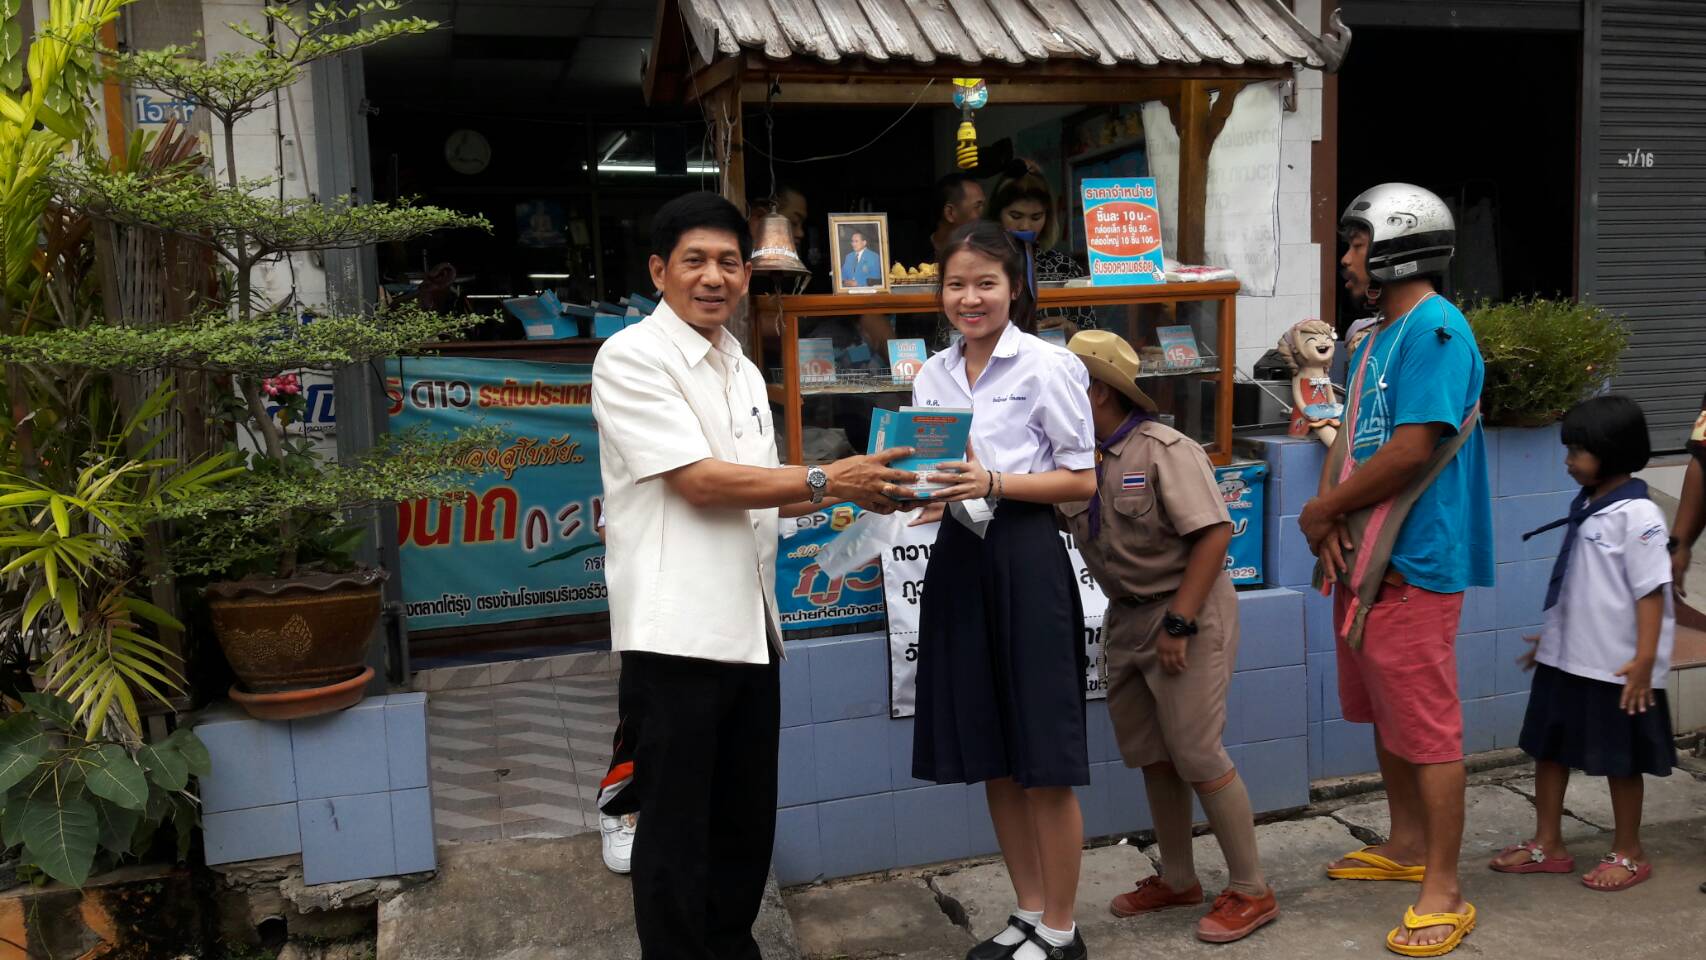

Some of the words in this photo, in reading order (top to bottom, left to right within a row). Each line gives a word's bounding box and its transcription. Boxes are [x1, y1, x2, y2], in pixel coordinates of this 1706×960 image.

[1086, 184, 1153, 200] ราคาจำหน่าย
[1096, 207, 1120, 222] ชิ้นละ
[1094, 224, 1121, 234] กล่องเล็ก
[1129, 222, 1137, 233] ชิ้น
[1091, 235, 1120, 247] กล่องใหญ่
[1121, 237, 1130, 245] 10
[1131, 234, 1140, 245] ชิ้น
[1094, 257, 1153, 274] รับรองความอร่อย
[1168, 348, 1185, 361] 15
[896, 363, 914, 376] 10
[411, 380, 471, 409] ดาว
[525, 496, 606, 551] กะ
[796, 514, 826, 529] OP
[834, 510, 851, 528] 5
[477, 584, 608, 611] ตรงข้ามโรงแรมริเวอร์วิว
